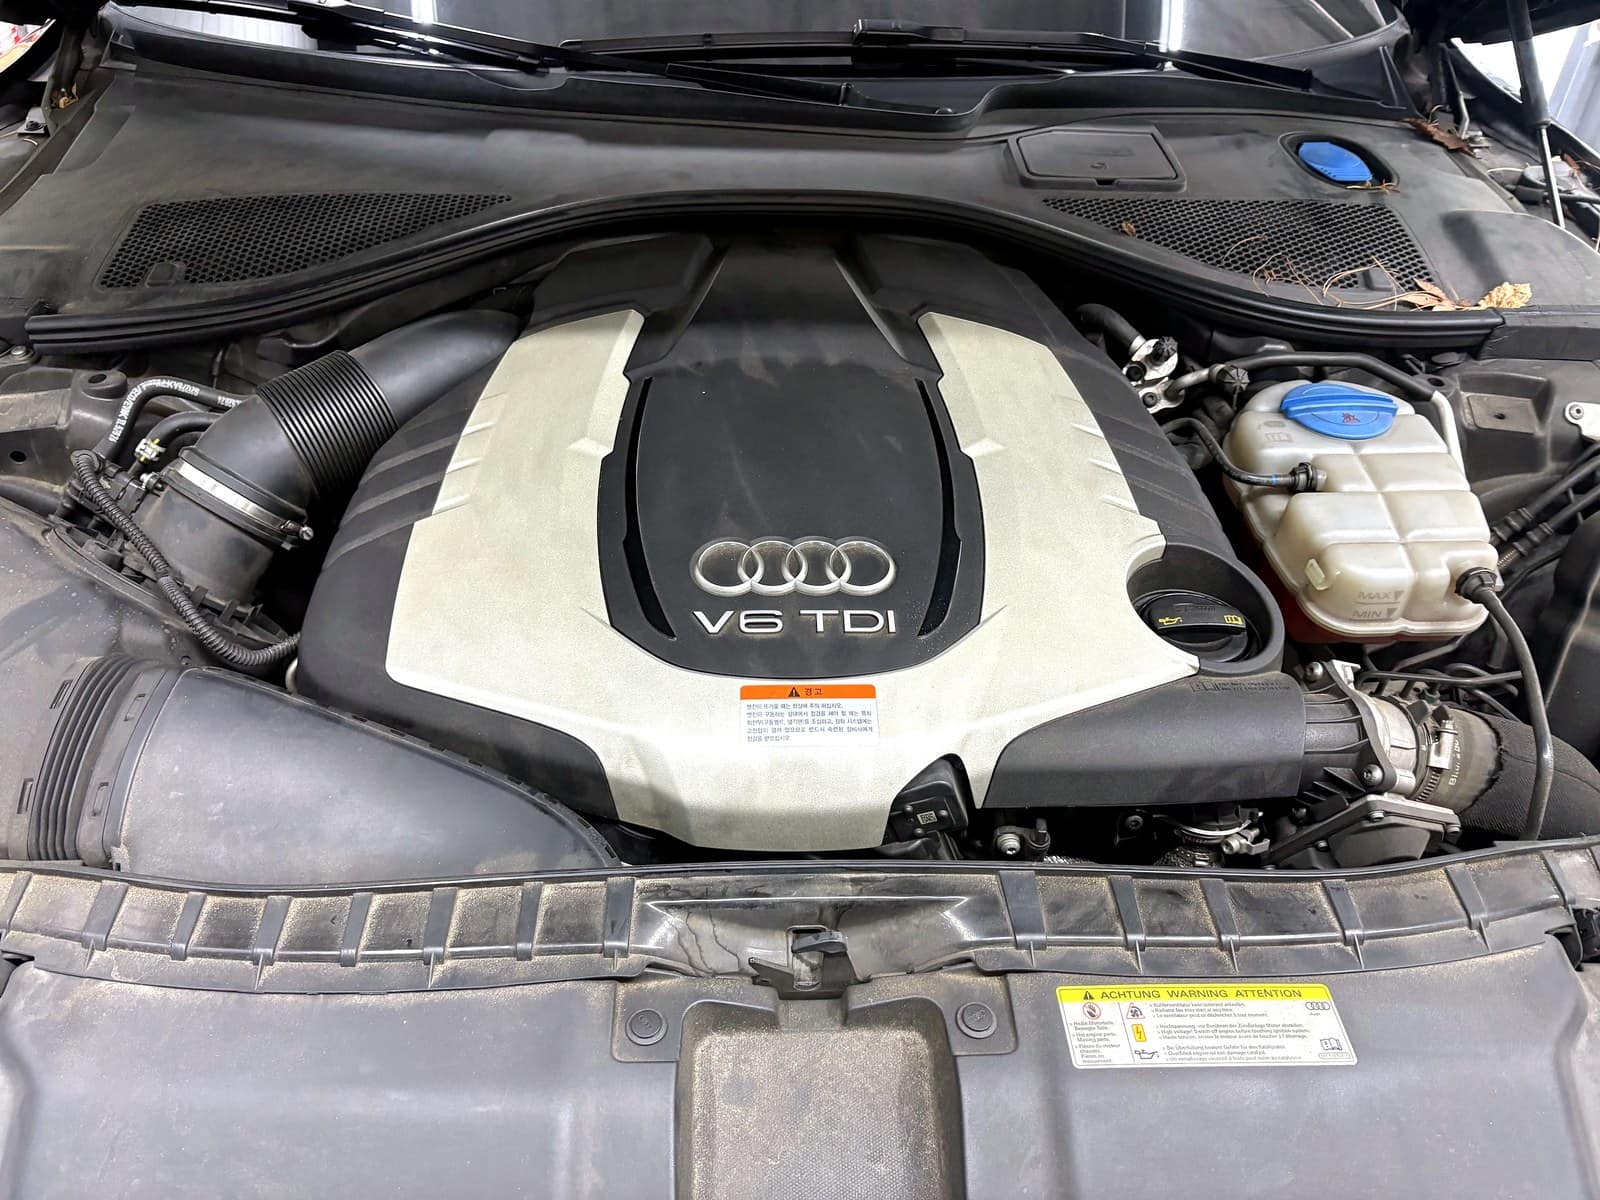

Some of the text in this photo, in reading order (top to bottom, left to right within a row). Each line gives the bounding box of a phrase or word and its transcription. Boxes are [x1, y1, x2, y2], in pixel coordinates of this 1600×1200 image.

[1358, 591, 1393, 600] MAX
[1352, 610, 1382, 618] MIN
[692, 609, 897, 634] V6 TDI
[1100, 989, 1302, 999] ACHTUNG WARNING ATTENTION
